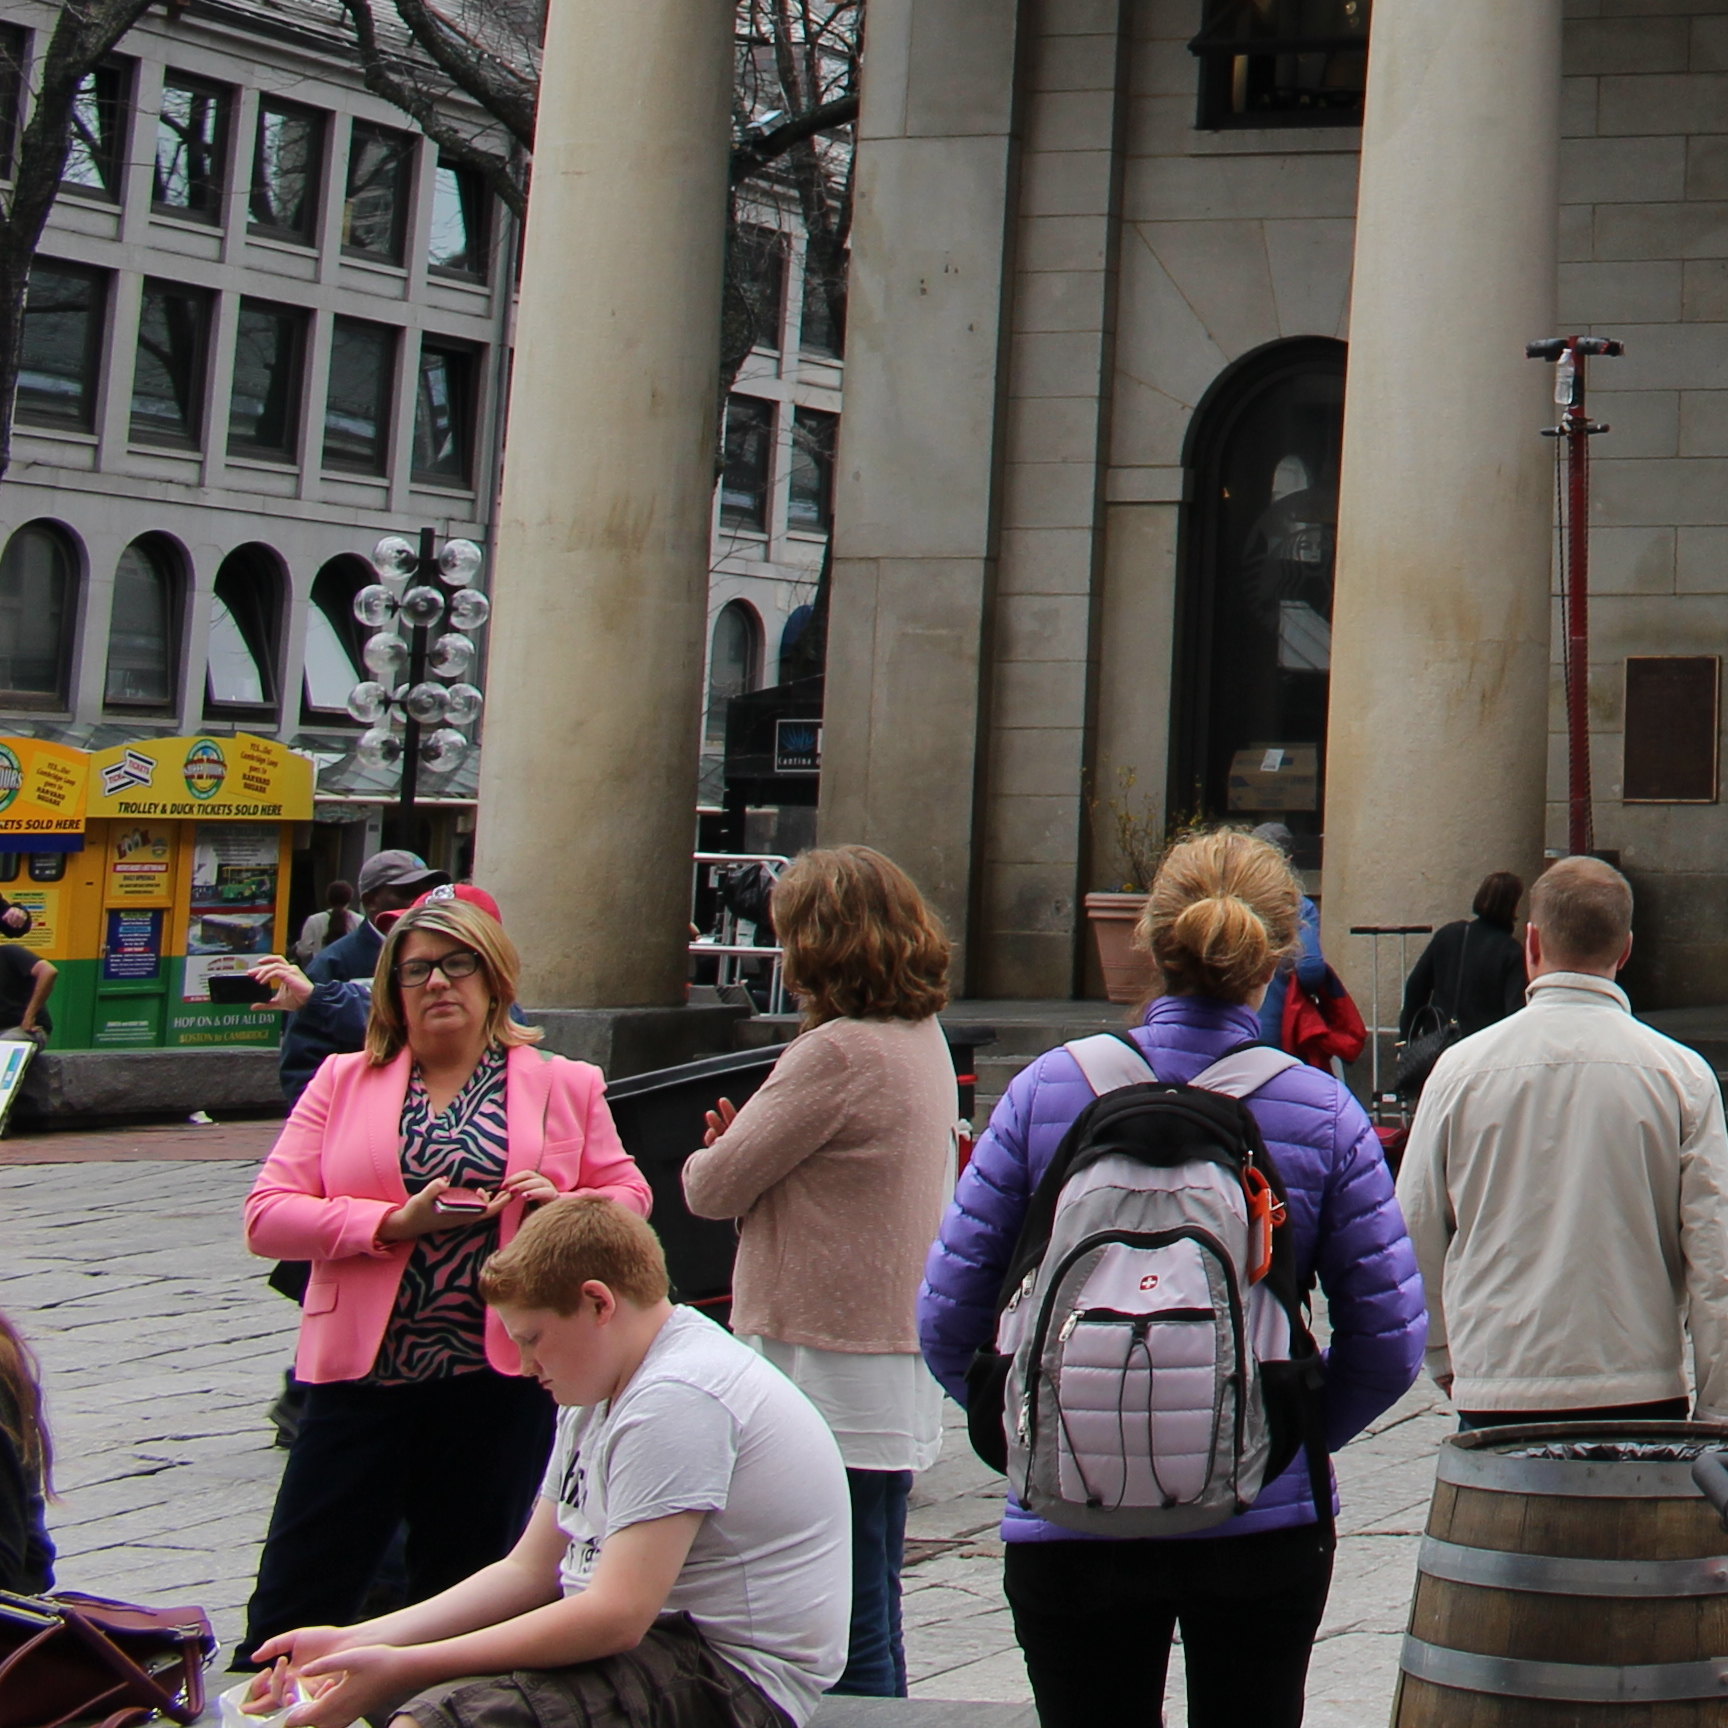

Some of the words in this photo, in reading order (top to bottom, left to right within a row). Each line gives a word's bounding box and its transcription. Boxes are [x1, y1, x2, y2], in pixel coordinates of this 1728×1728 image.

[778, 757, 811, 766] Cantina
[118, 802, 160, 814] TROLLEY
[160, 802, 168, 814] &
[170, 803, 195, 815] DUCK
[196, 803, 234, 815] TICKETS
[235, 804, 259, 815] SOLD
[261, 804, 284, 816] HERE
[25, 819, 54, 830] SOLD
[55, 819, 82, 830] HERE
[174, 1016, 196, 1028] HOP
[197, 1016, 213, 1027] ON
[214, 1016, 221, 1026] &
[223, 1015, 240, 1026] OFF
[241, 1014, 256, 1025] ALL
[258, 1013, 276, 1024] DAY
[179, 1033, 213, 1044] BOSTON
[223, 1030, 269, 1041] CAMBRIDGE
